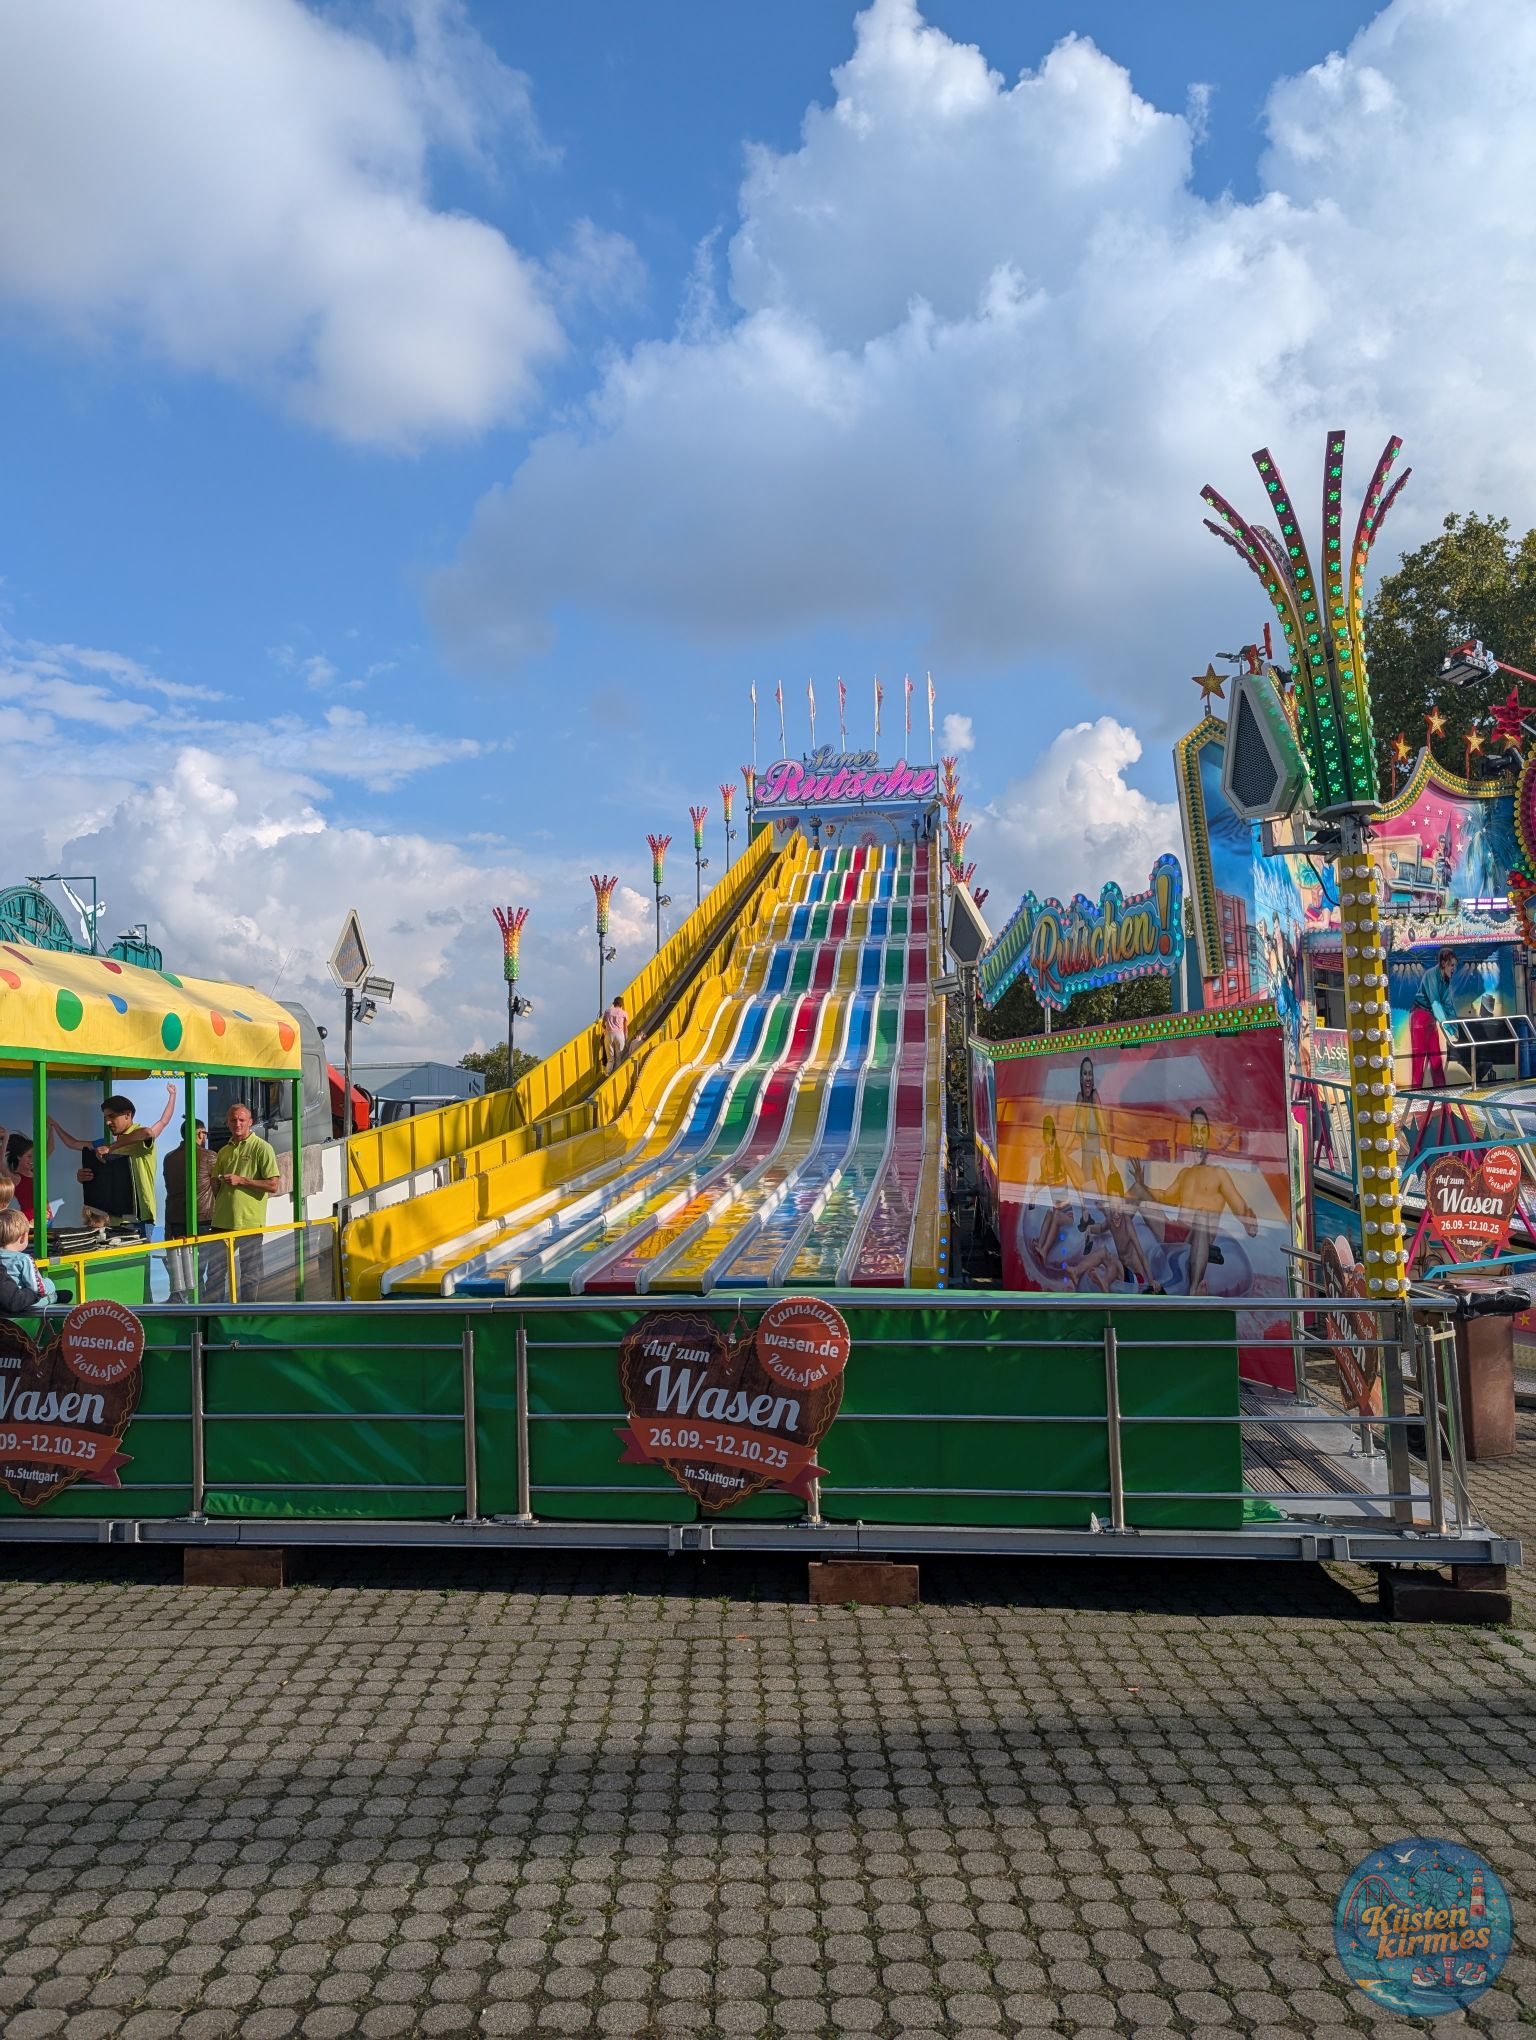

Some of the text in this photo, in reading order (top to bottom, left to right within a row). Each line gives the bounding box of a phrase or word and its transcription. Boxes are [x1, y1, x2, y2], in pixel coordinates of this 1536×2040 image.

[804, 744, 879, 776] Super
[755, 758, 937, 804] Rutsche
[1435, 1174, 1464, 1187] Auf zum
[1486, 1166, 1517, 1176] wasen.de
[1437, 1188, 1503, 1215] Wasen
[70, 1306, 136, 1333] Cannstatter
[769, 1304, 841, 1338] Cannstatter
[69, 1335, 135, 1352] wasen.de
[642, 1339, 710, 1363] Auf zum
[764, 1333, 839, 1358] wasen.de
[73, 1353, 127, 1381] Volksfest
[768, 1353, 828, 1387] Volksfest
[645, 1365, 801, 1432] Wasen
